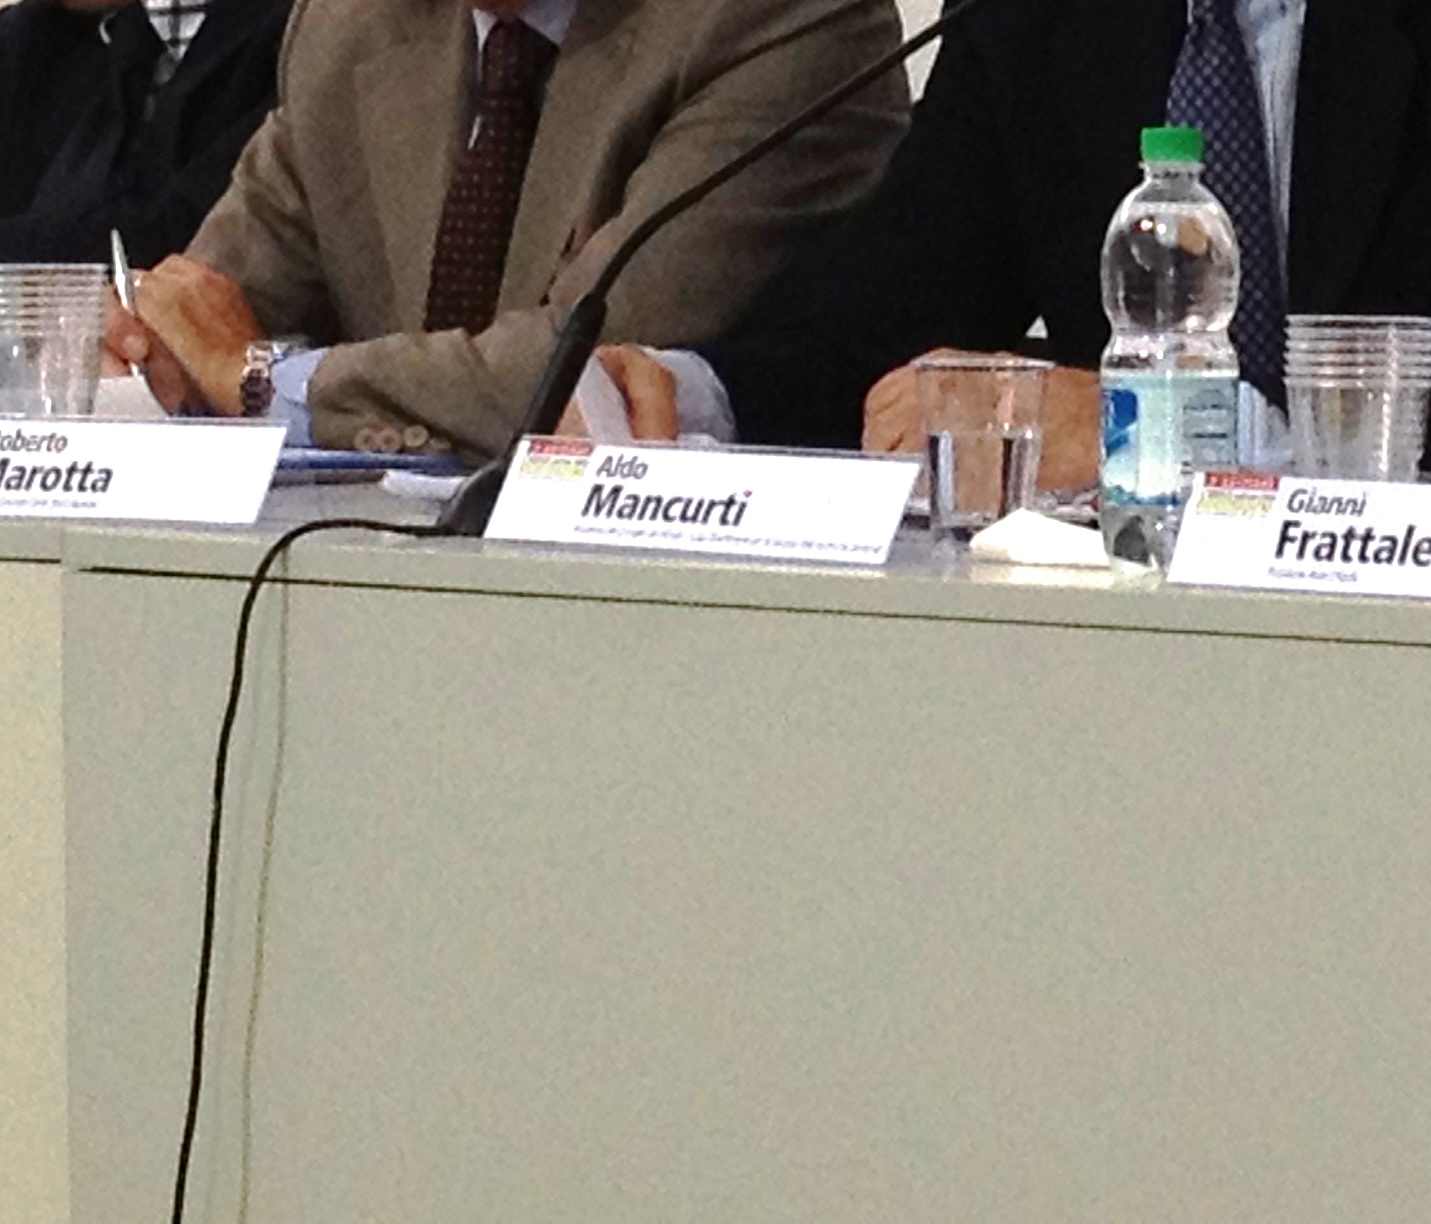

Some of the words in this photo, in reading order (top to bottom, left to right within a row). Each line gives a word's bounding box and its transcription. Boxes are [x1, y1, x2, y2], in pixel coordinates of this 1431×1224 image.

[0, 427, 68, 454] oberto
[595, 453, 649, 480] Aldo
[580, 483, 753, 527] Mancurti
[1286, 486, 1367, 517] Gianni
